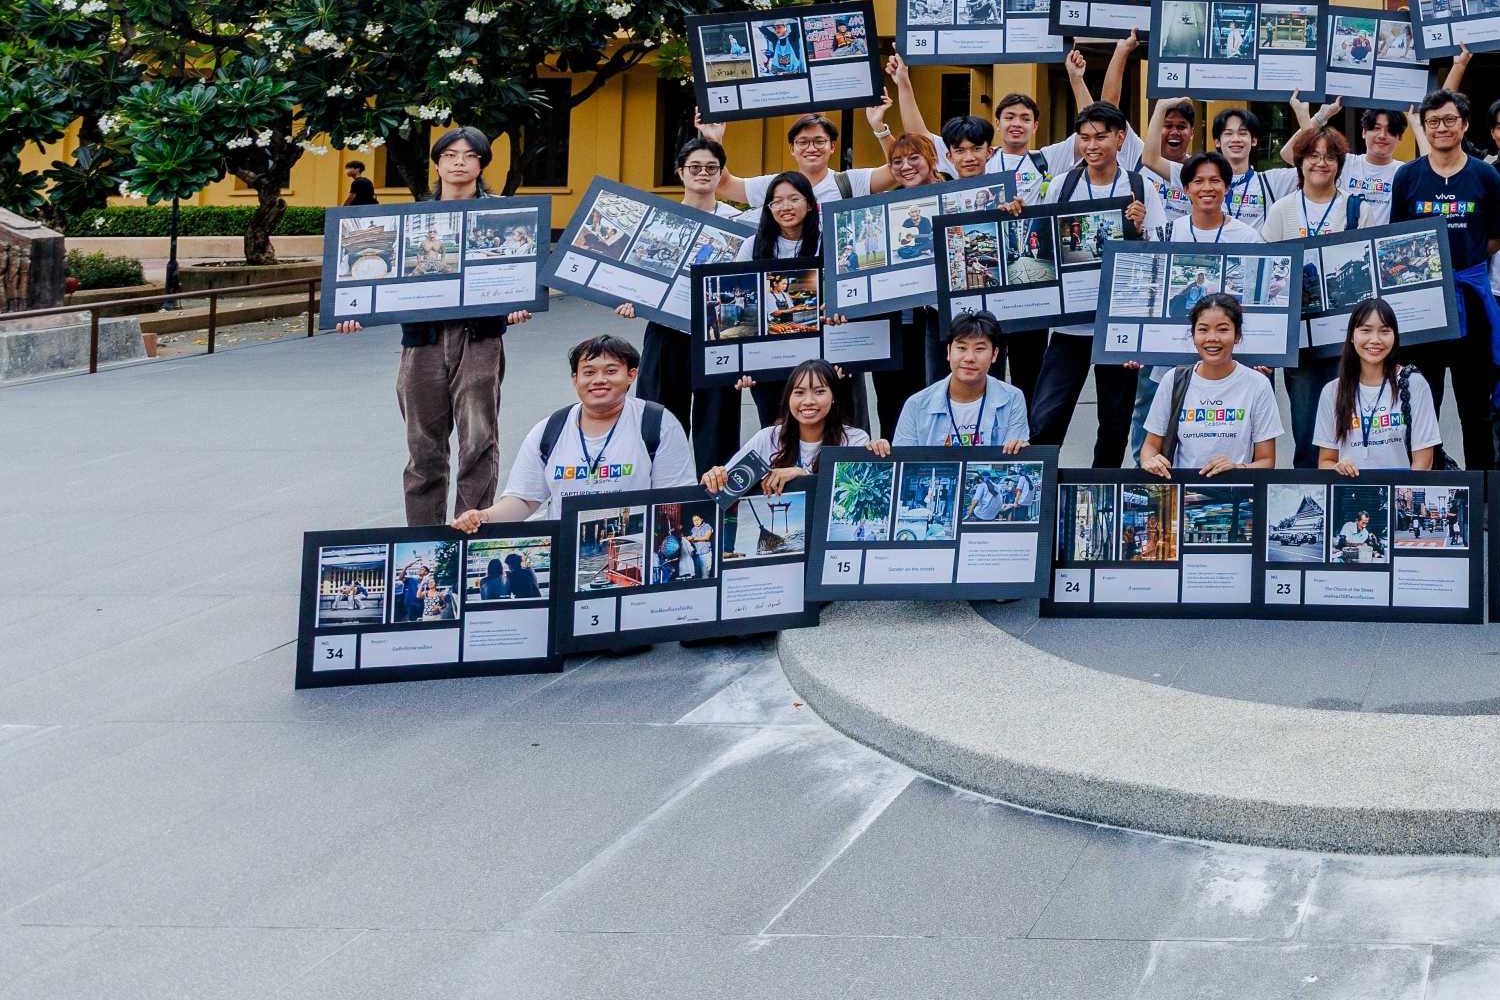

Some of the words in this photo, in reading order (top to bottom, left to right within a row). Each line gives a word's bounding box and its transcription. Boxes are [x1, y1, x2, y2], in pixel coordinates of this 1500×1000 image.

[1435, 193, 1456, 201] vivo
[1416, 201, 1477, 214] ACADEMY
[715, 355, 730, 366] 27
[1179, 408, 1246, 422] ACADEMY
[837, 561, 851, 573] 15
[1065, 581, 1080, 593] 24
[1276, 583, 1291, 595] 23
[591, 614, 599, 626] 3
[326, 647, 344, 660] 34
